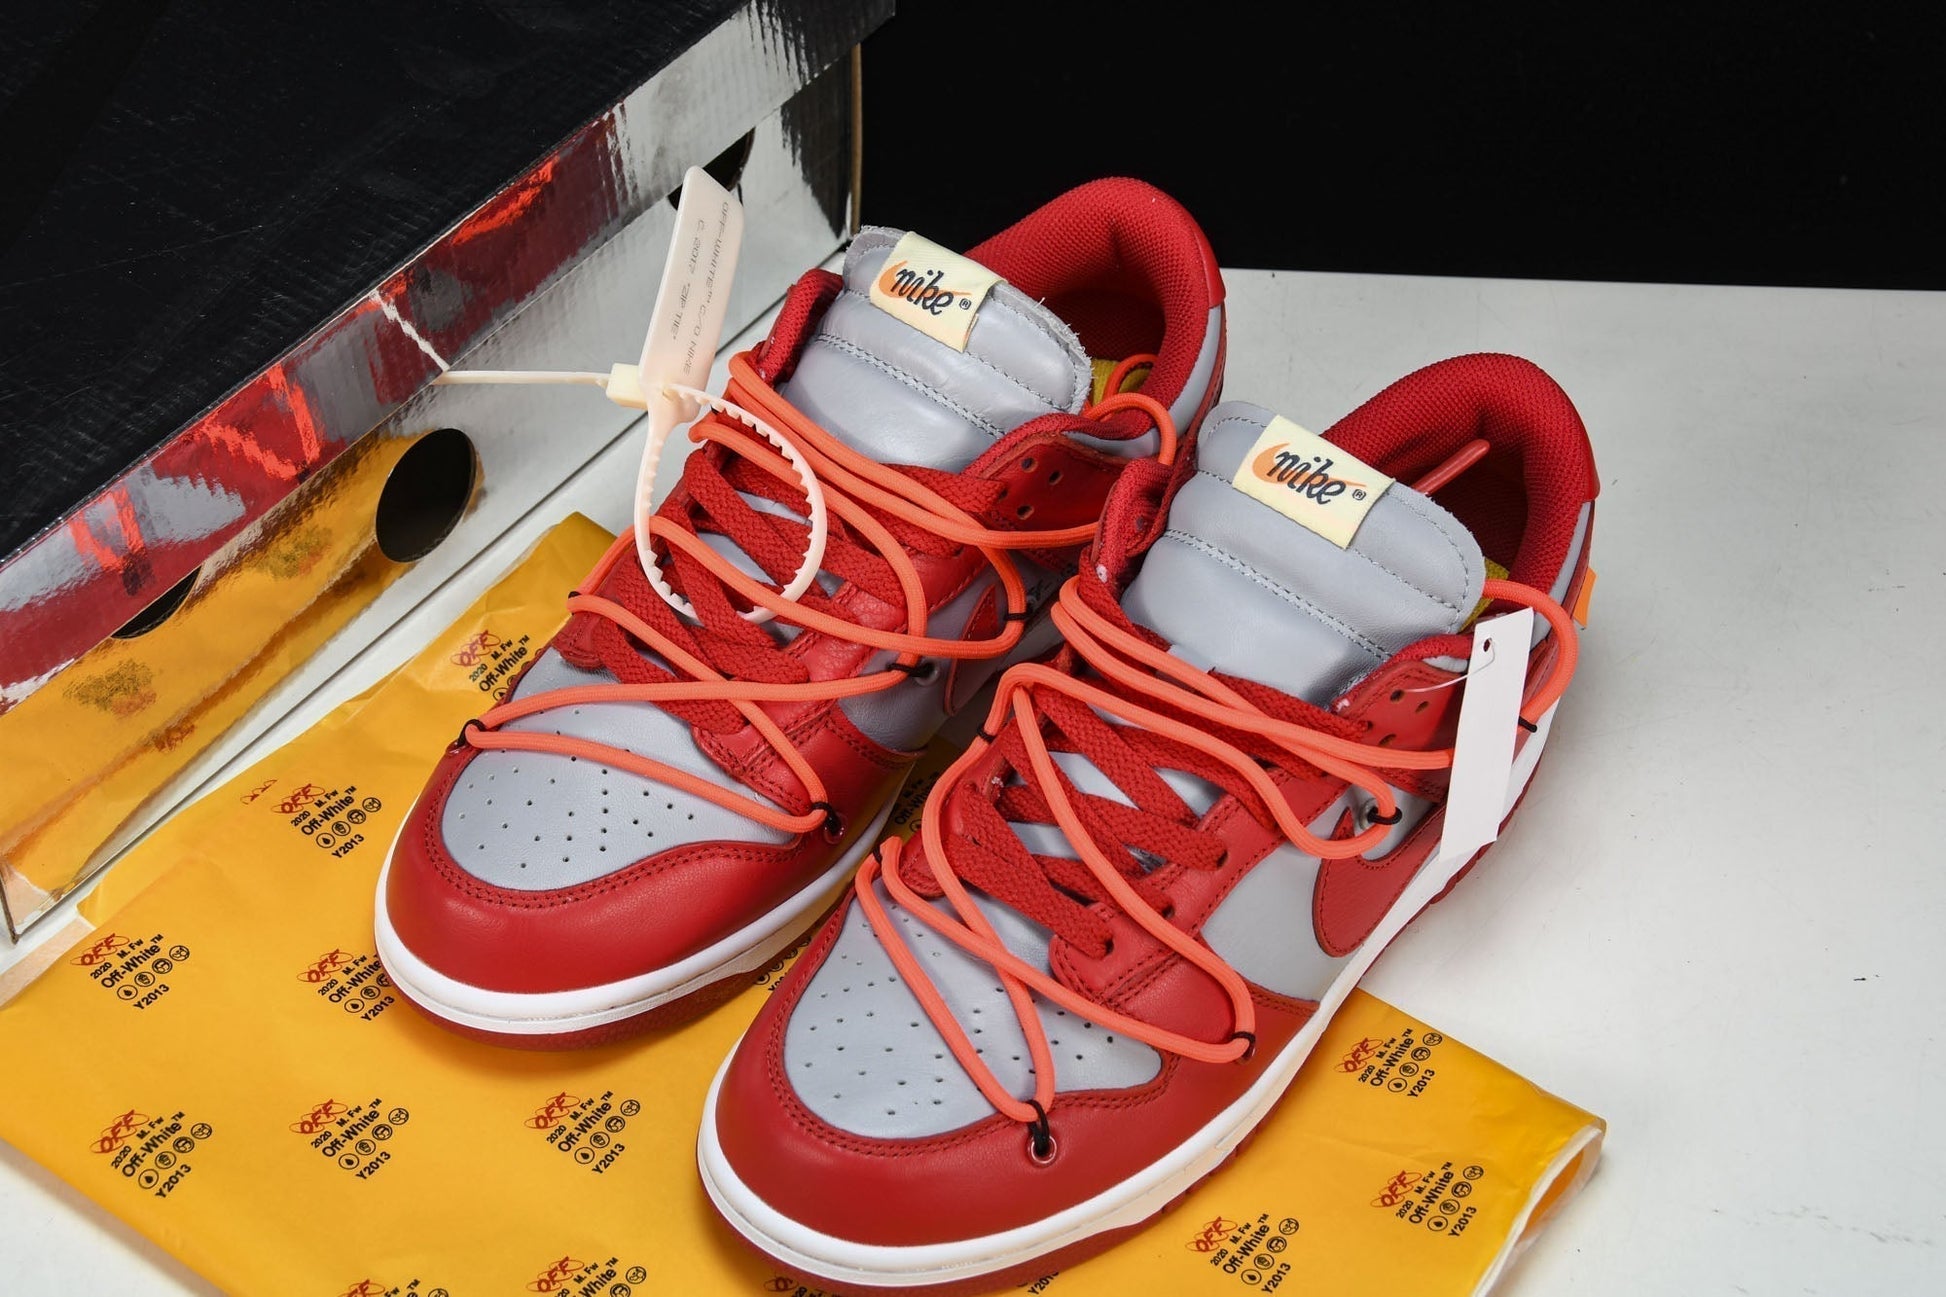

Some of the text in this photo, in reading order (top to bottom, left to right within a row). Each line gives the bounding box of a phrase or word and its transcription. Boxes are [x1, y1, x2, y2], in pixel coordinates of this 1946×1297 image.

[460, 630, 489, 667] OFF
[469, 663, 488, 682] 2020
[281, 783, 312, 813] OFF
[290, 810, 311, 827] 2020
[331, 833, 365, 859] Y2013
[81, 933, 116, 965] OFF
[90, 961, 112, 980] 2020
[307, 948, 340, 983] OFF
[133, 984, 170, 1010] Y2013
[317, 978, 339, 996] 2020
[360, 996, 395, 1022] Y2013
[1344, 1037, 1369, 1072] OFF
[1358, 1064, 1375, 1083] 2020
[1407, 1069, 1435, 1098] Y2013
[300, 1098, 334, 1134] OFF
[535, 1091, 566, 1129] OFF
[100, 1109, 135, 1153] OFF
[311, 1130, 332, 1149] 2020
[546, 1124, 567, 1144] 2020
[111, 1145, 132, 1169] 2020
[355, 1151, 391, 1180] Y2013
[592, 1143, 625, 1174] Y2013
[155, 1163, 191, 1198] Y2013
[1381, 1169, 1408, 1207] OFF
[1396, 1199, 1414, 1219] 2020
[1448, 1206, 1477, 1237] Y2013
[1196, 1216, 1222, 1252] OFF
[1210, 1248, 1229, 1267] 2020
[537, 1256, 569, 1292] OFF
[1261, 1262, 1291, 1295] Y2013
